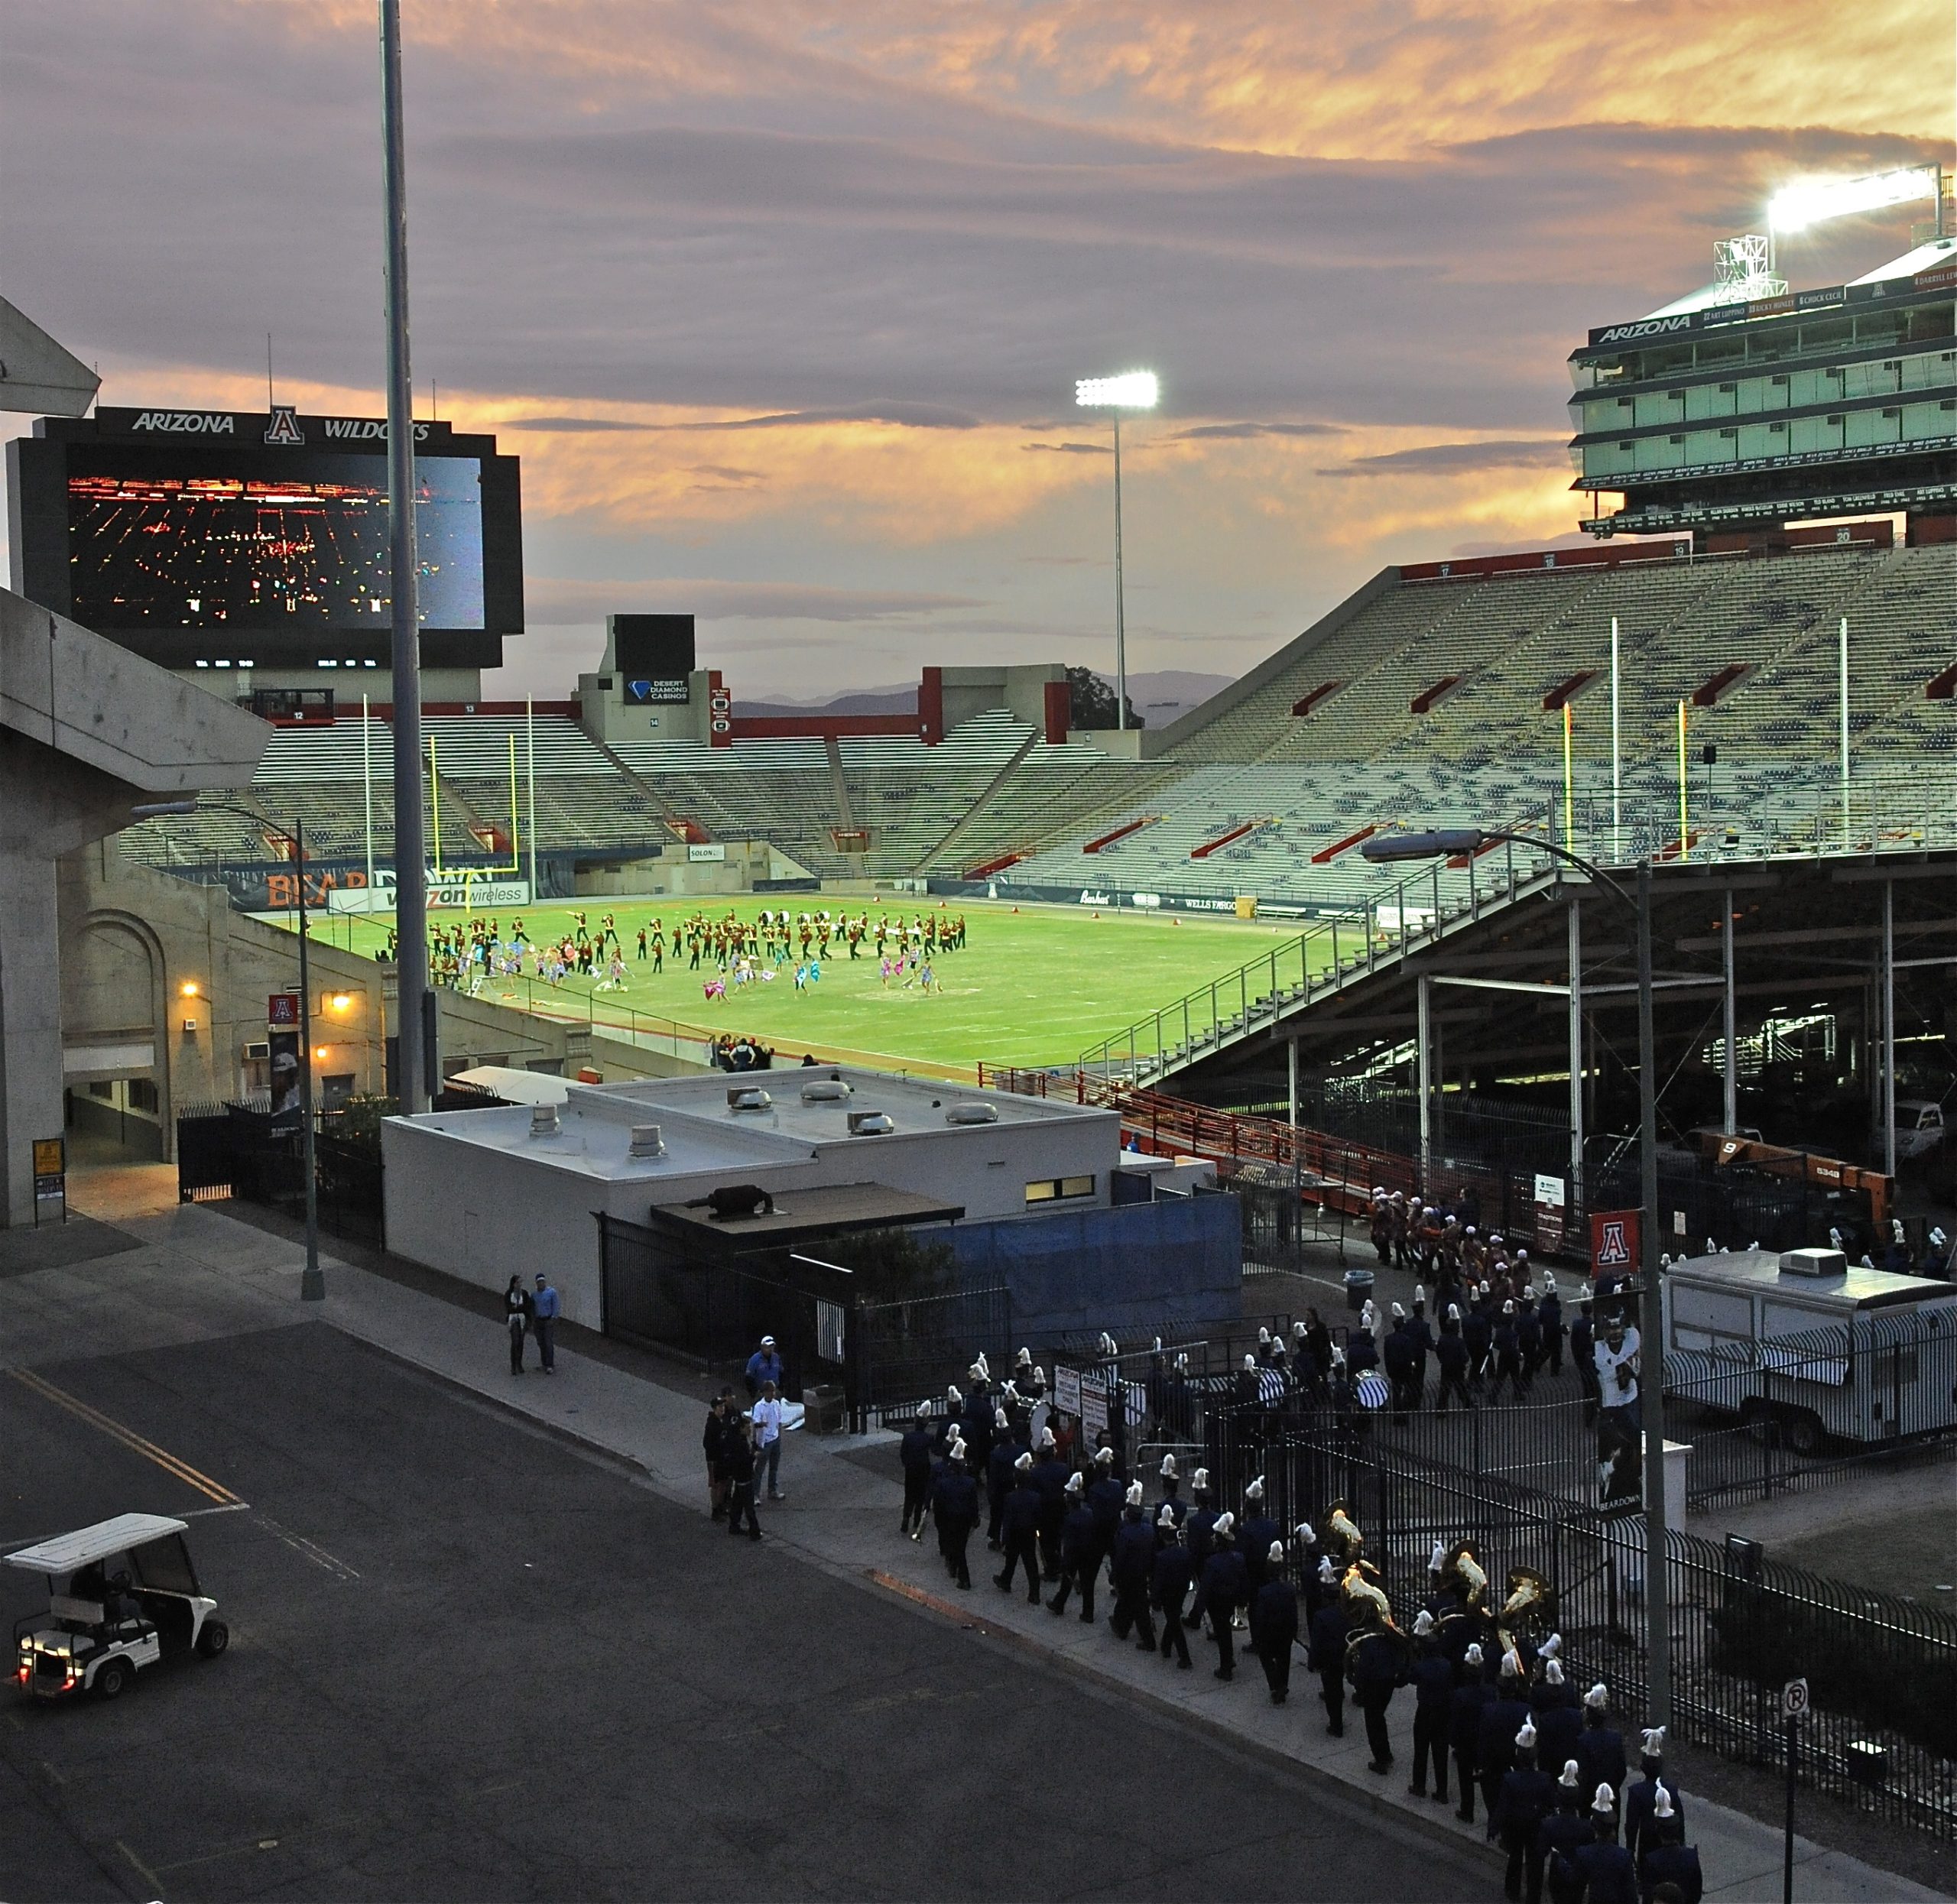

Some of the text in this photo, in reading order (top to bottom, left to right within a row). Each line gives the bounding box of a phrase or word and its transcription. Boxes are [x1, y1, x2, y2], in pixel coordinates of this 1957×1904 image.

[1804, 294, 1824, 303] CHUCK
[1825, 291, 1842, 300] CECIL
[1598, 315, 1691, 342] ARIZONA
[132, 413, 234, 433] ARIZONA
[1837, 532, 1850, 543] 20
[1675, 547, 1684, 556] 19
[1546, 558, 1554, 568] 18
[294, 712, 303, 720] 12
[467, 888, 523, 905] wireless
[1185, 899, 1237, 910] WELLS FARGO
[1723, 1142, 1737, 1153] 9
[1597, 1221, 1630, 1266] A
[1599, 1494, 1641, 1512] BEARDOWN
